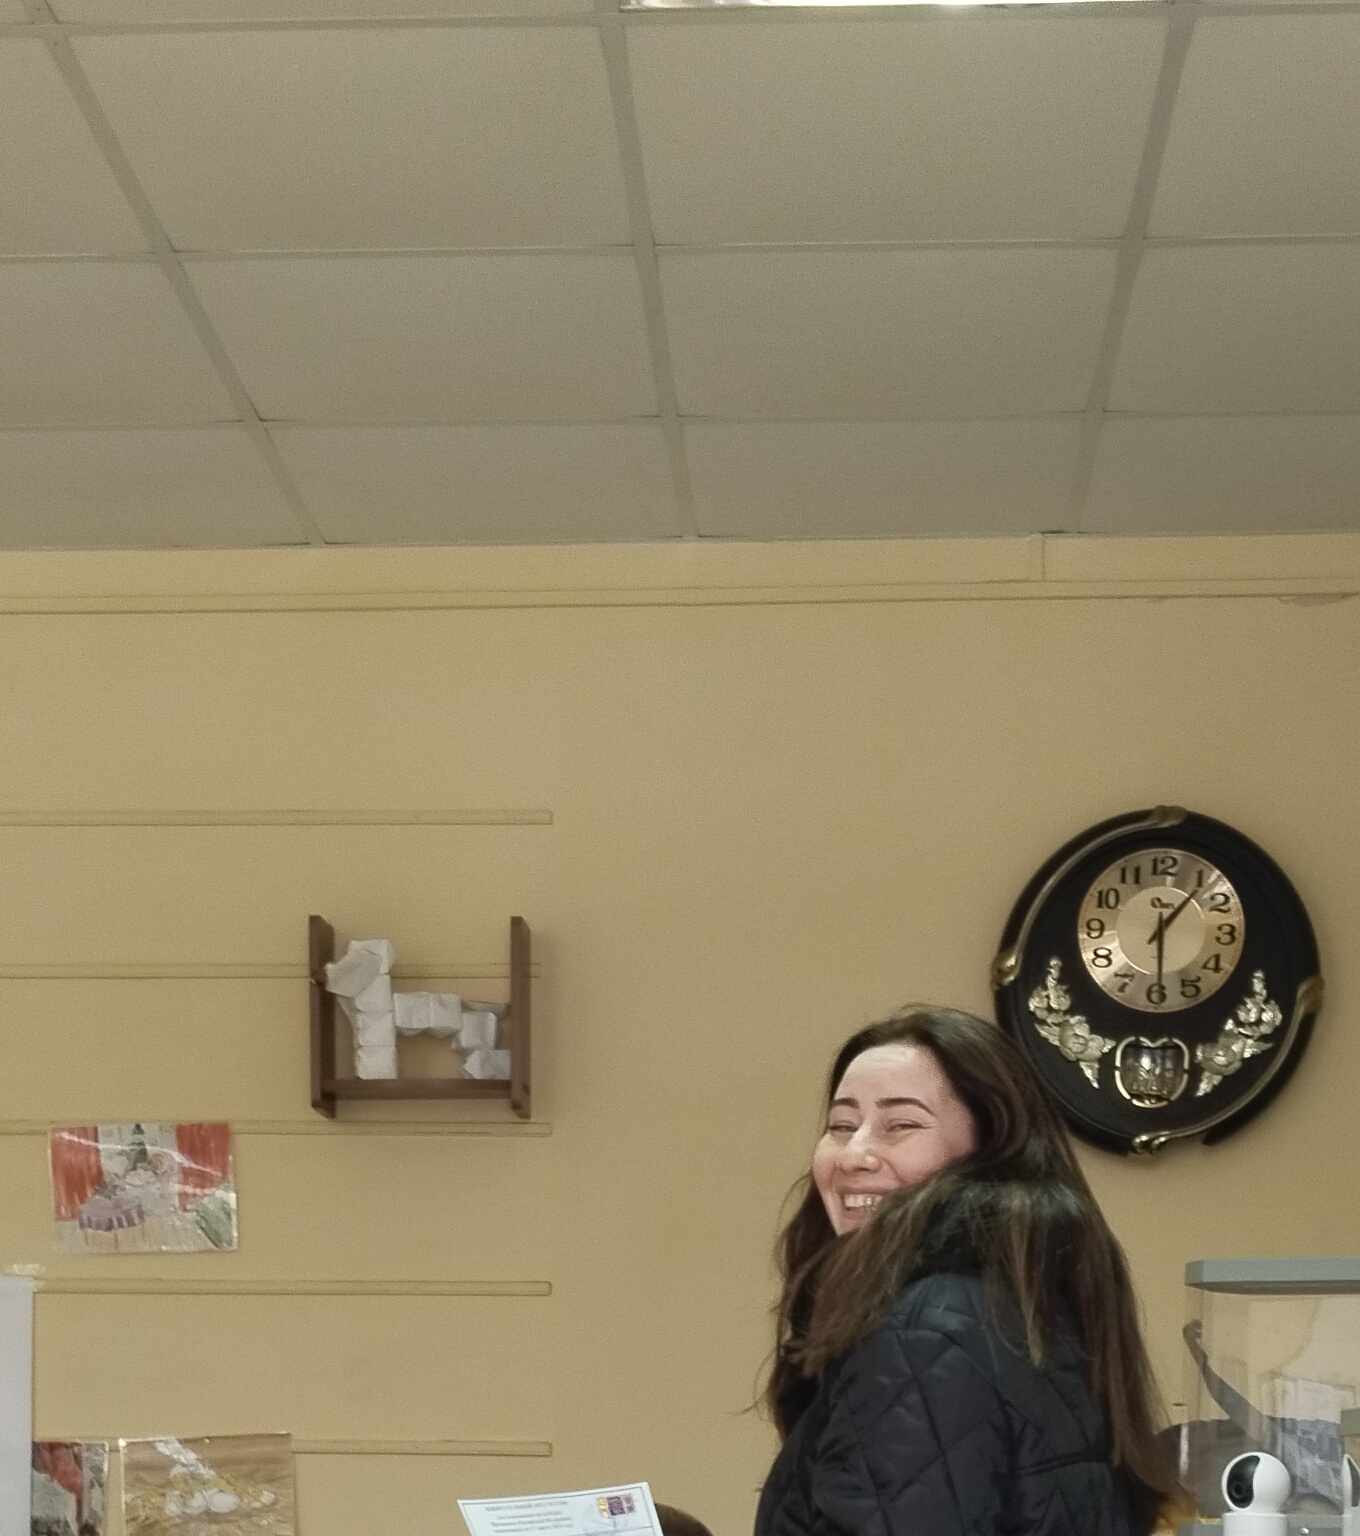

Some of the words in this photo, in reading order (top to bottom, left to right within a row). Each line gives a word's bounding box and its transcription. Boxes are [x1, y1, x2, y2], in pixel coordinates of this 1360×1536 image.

[1119, 866, 1142, 885] 11
[1150, 855, 1179, 877] 12
[1196, 867, 1205, 888] 1
[1094, 887, 1120, 910] 10
[1209, 893, 1231, 914] 2
[1085, 918, 1105, 939] 9
[1215, 923, 1237, 946] 3
[1092, 947, 1113, 968] 8
[1202, 953, 1222, 974] 4
[1114, 973, 1135, 993] 7
[1180, 976, 1201, 999] 5
[1146, 983, 1167, 1005] 6
